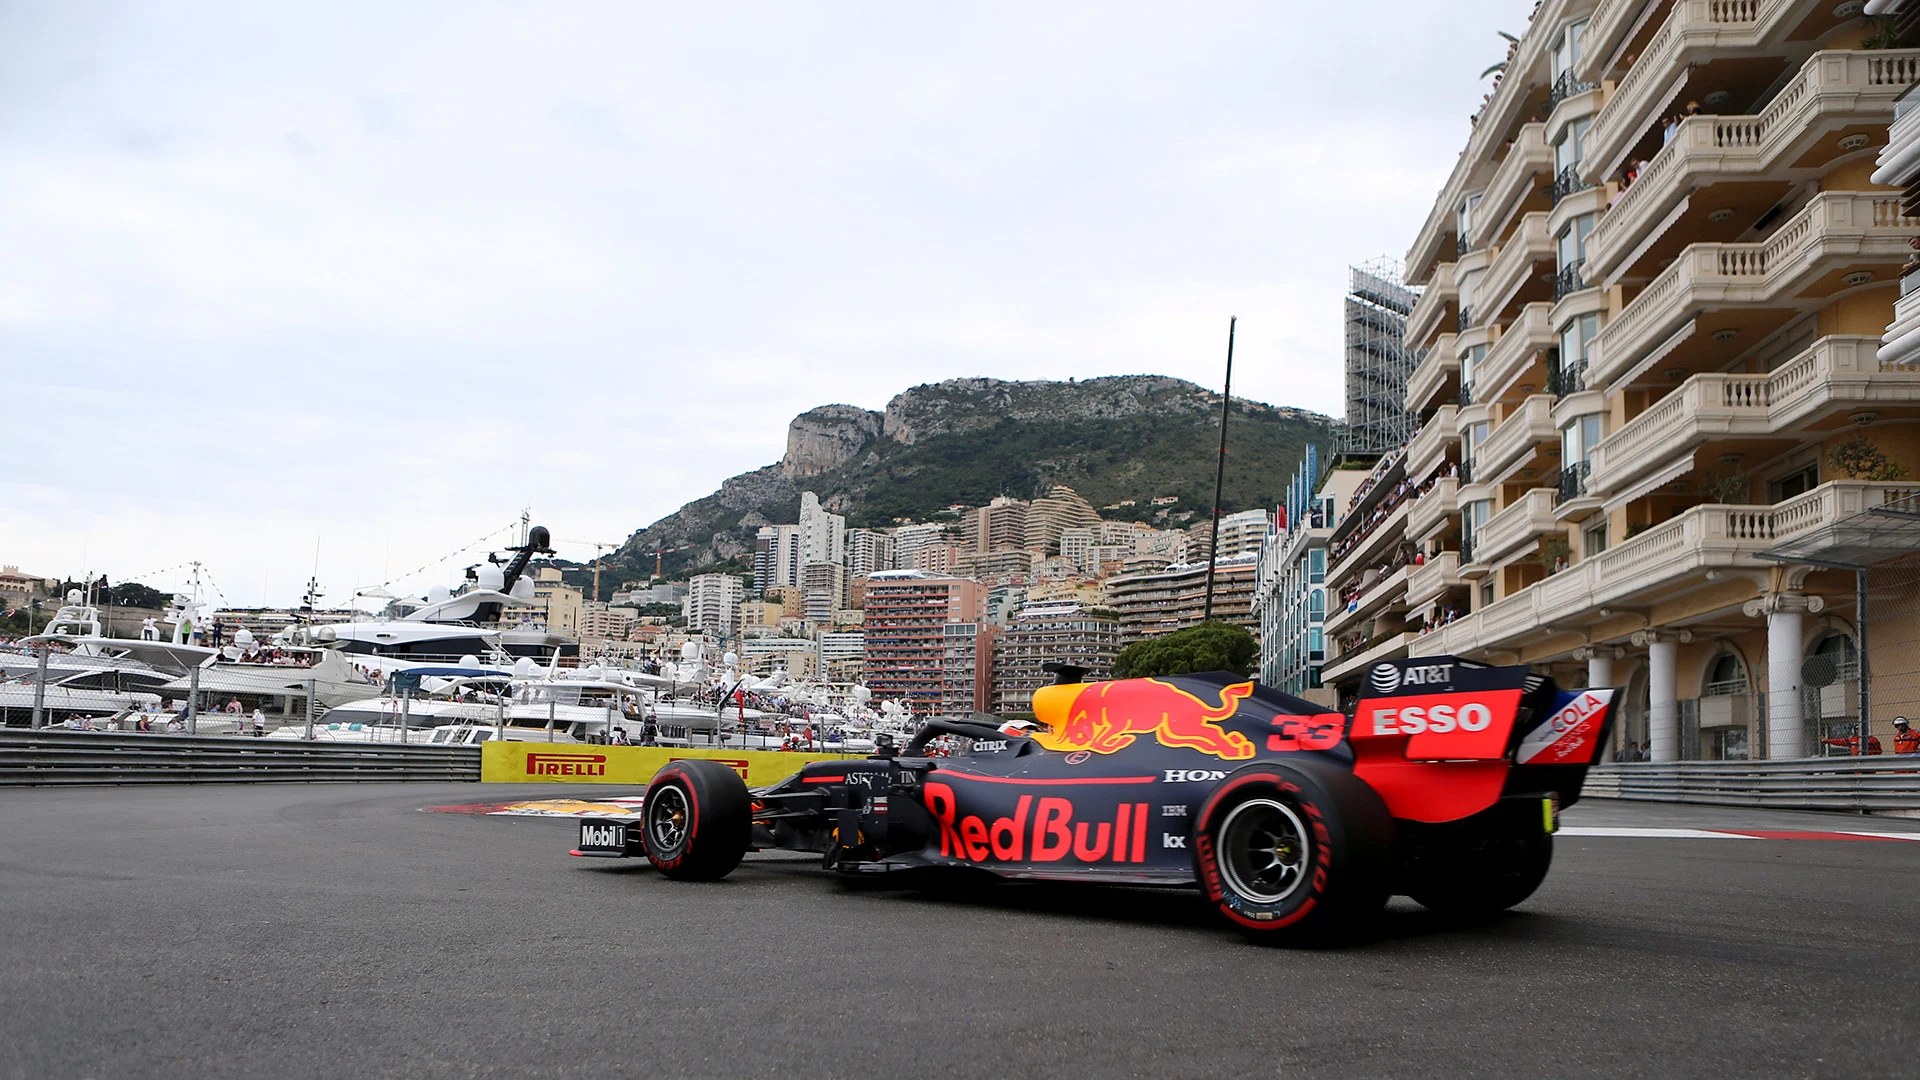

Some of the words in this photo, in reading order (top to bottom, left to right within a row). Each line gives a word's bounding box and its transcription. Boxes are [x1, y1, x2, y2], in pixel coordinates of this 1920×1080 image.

[1403, 664, 1454, 686] AT&T
[1373, 703, 1492, 735] ESSO
[1551, 694, 1603, 733] COLA
[1267, 713, 1346, 751] 33
[527, 753, 607, 776] PIRELLI
[1161, 805, 1188, 816] IBM
[582, 825, 616, 846] Mobil
[1195, 834, 1223, 902] PIRELLI
